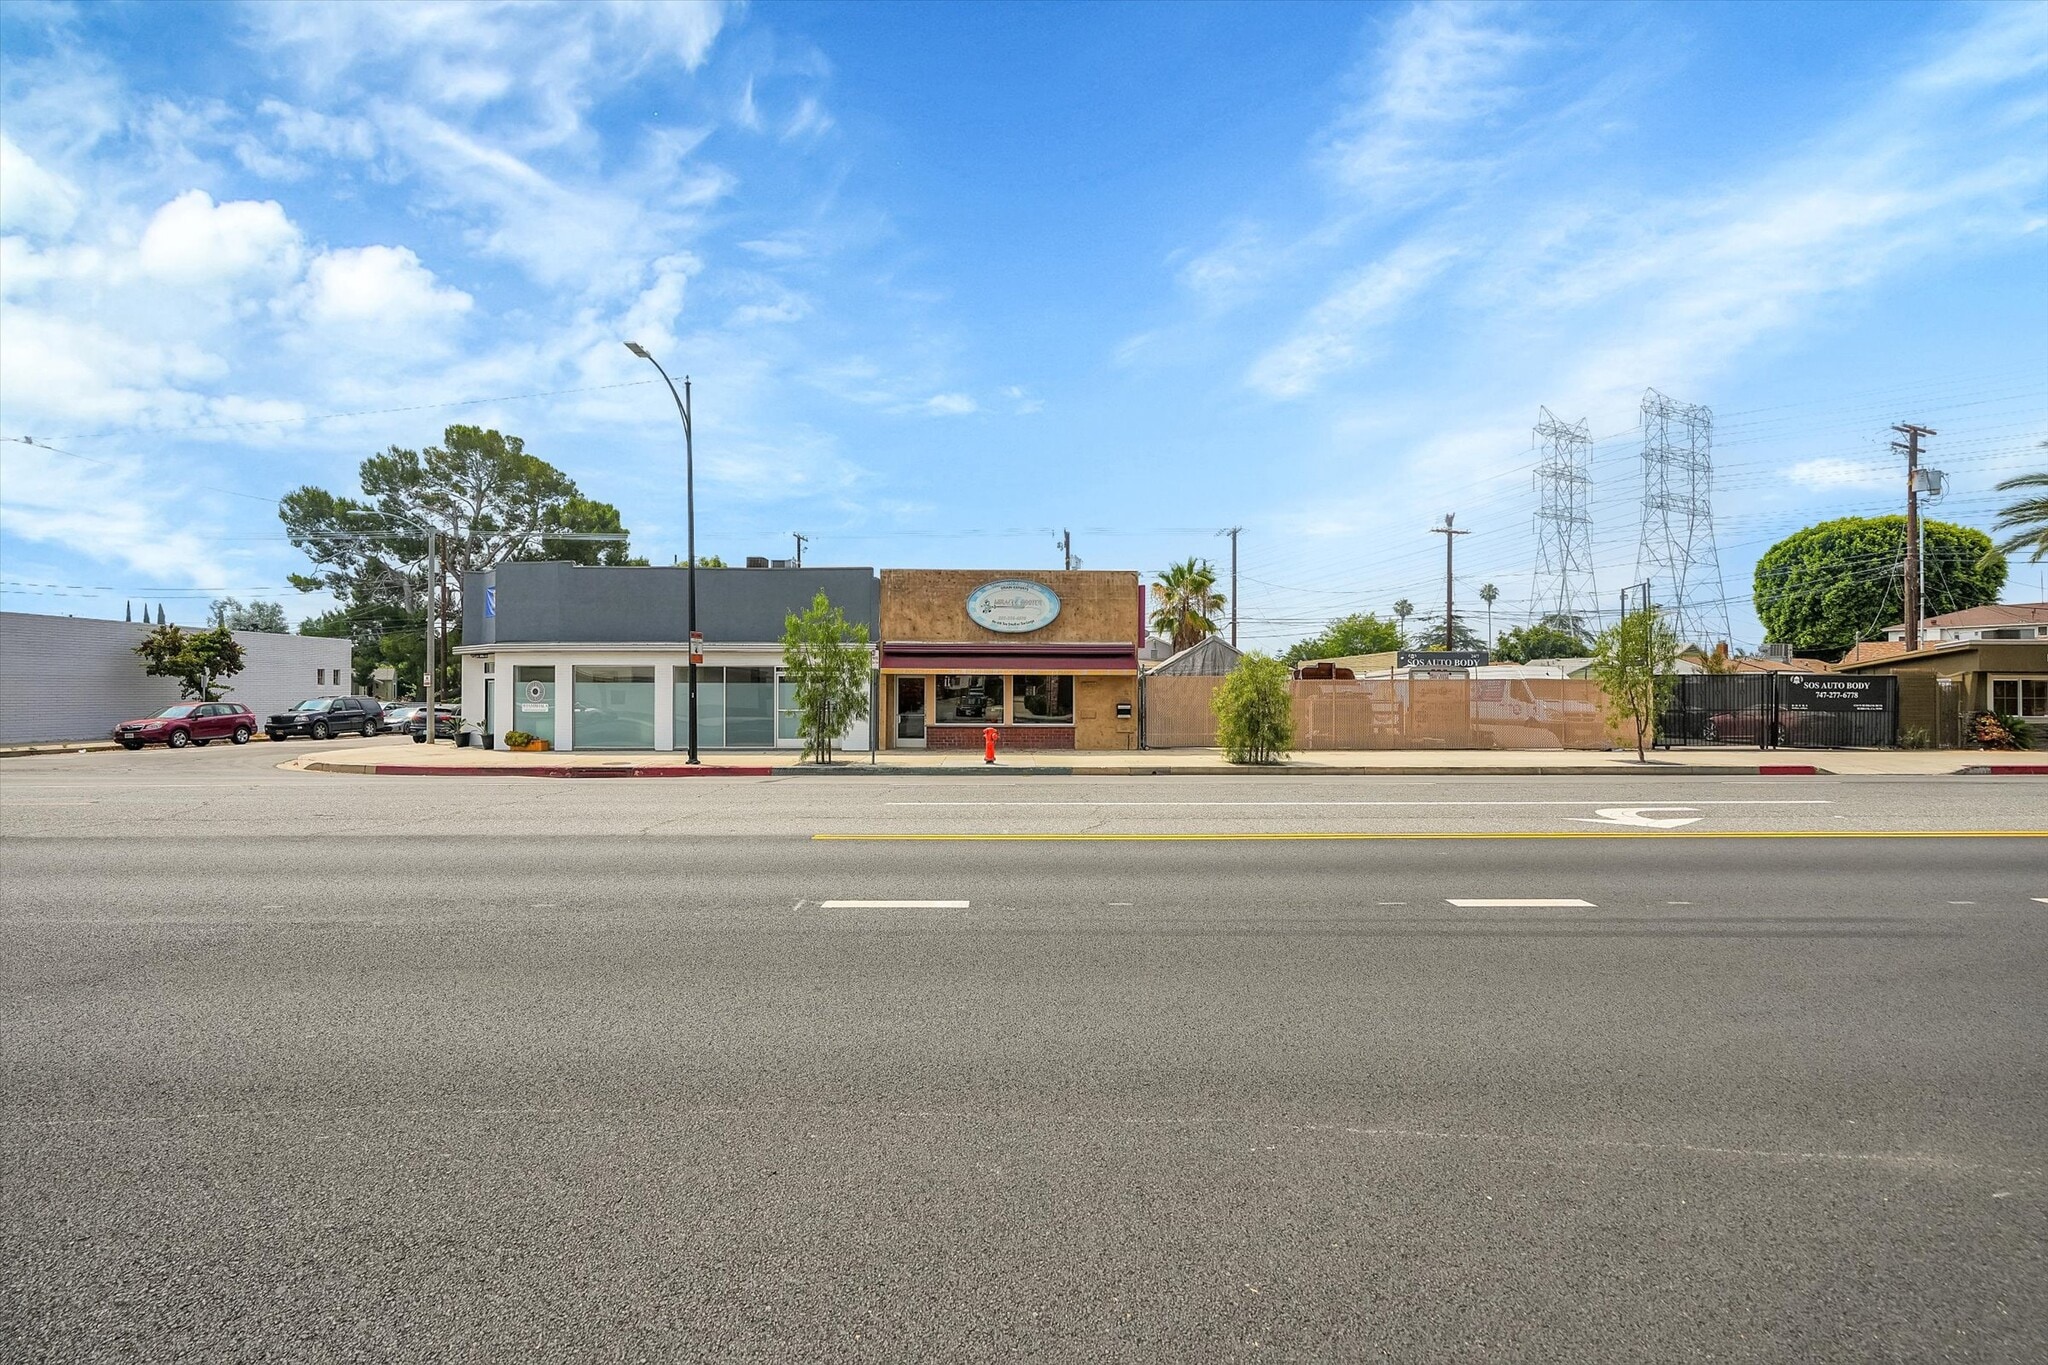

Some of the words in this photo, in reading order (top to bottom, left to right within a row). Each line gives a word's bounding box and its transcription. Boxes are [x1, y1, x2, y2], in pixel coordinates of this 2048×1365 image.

[1426, 659, 1452, 667] AUTO
[1454, 659, 1480, 667] BODY
[1815, 691, 1859, 699] 747-277-6778
